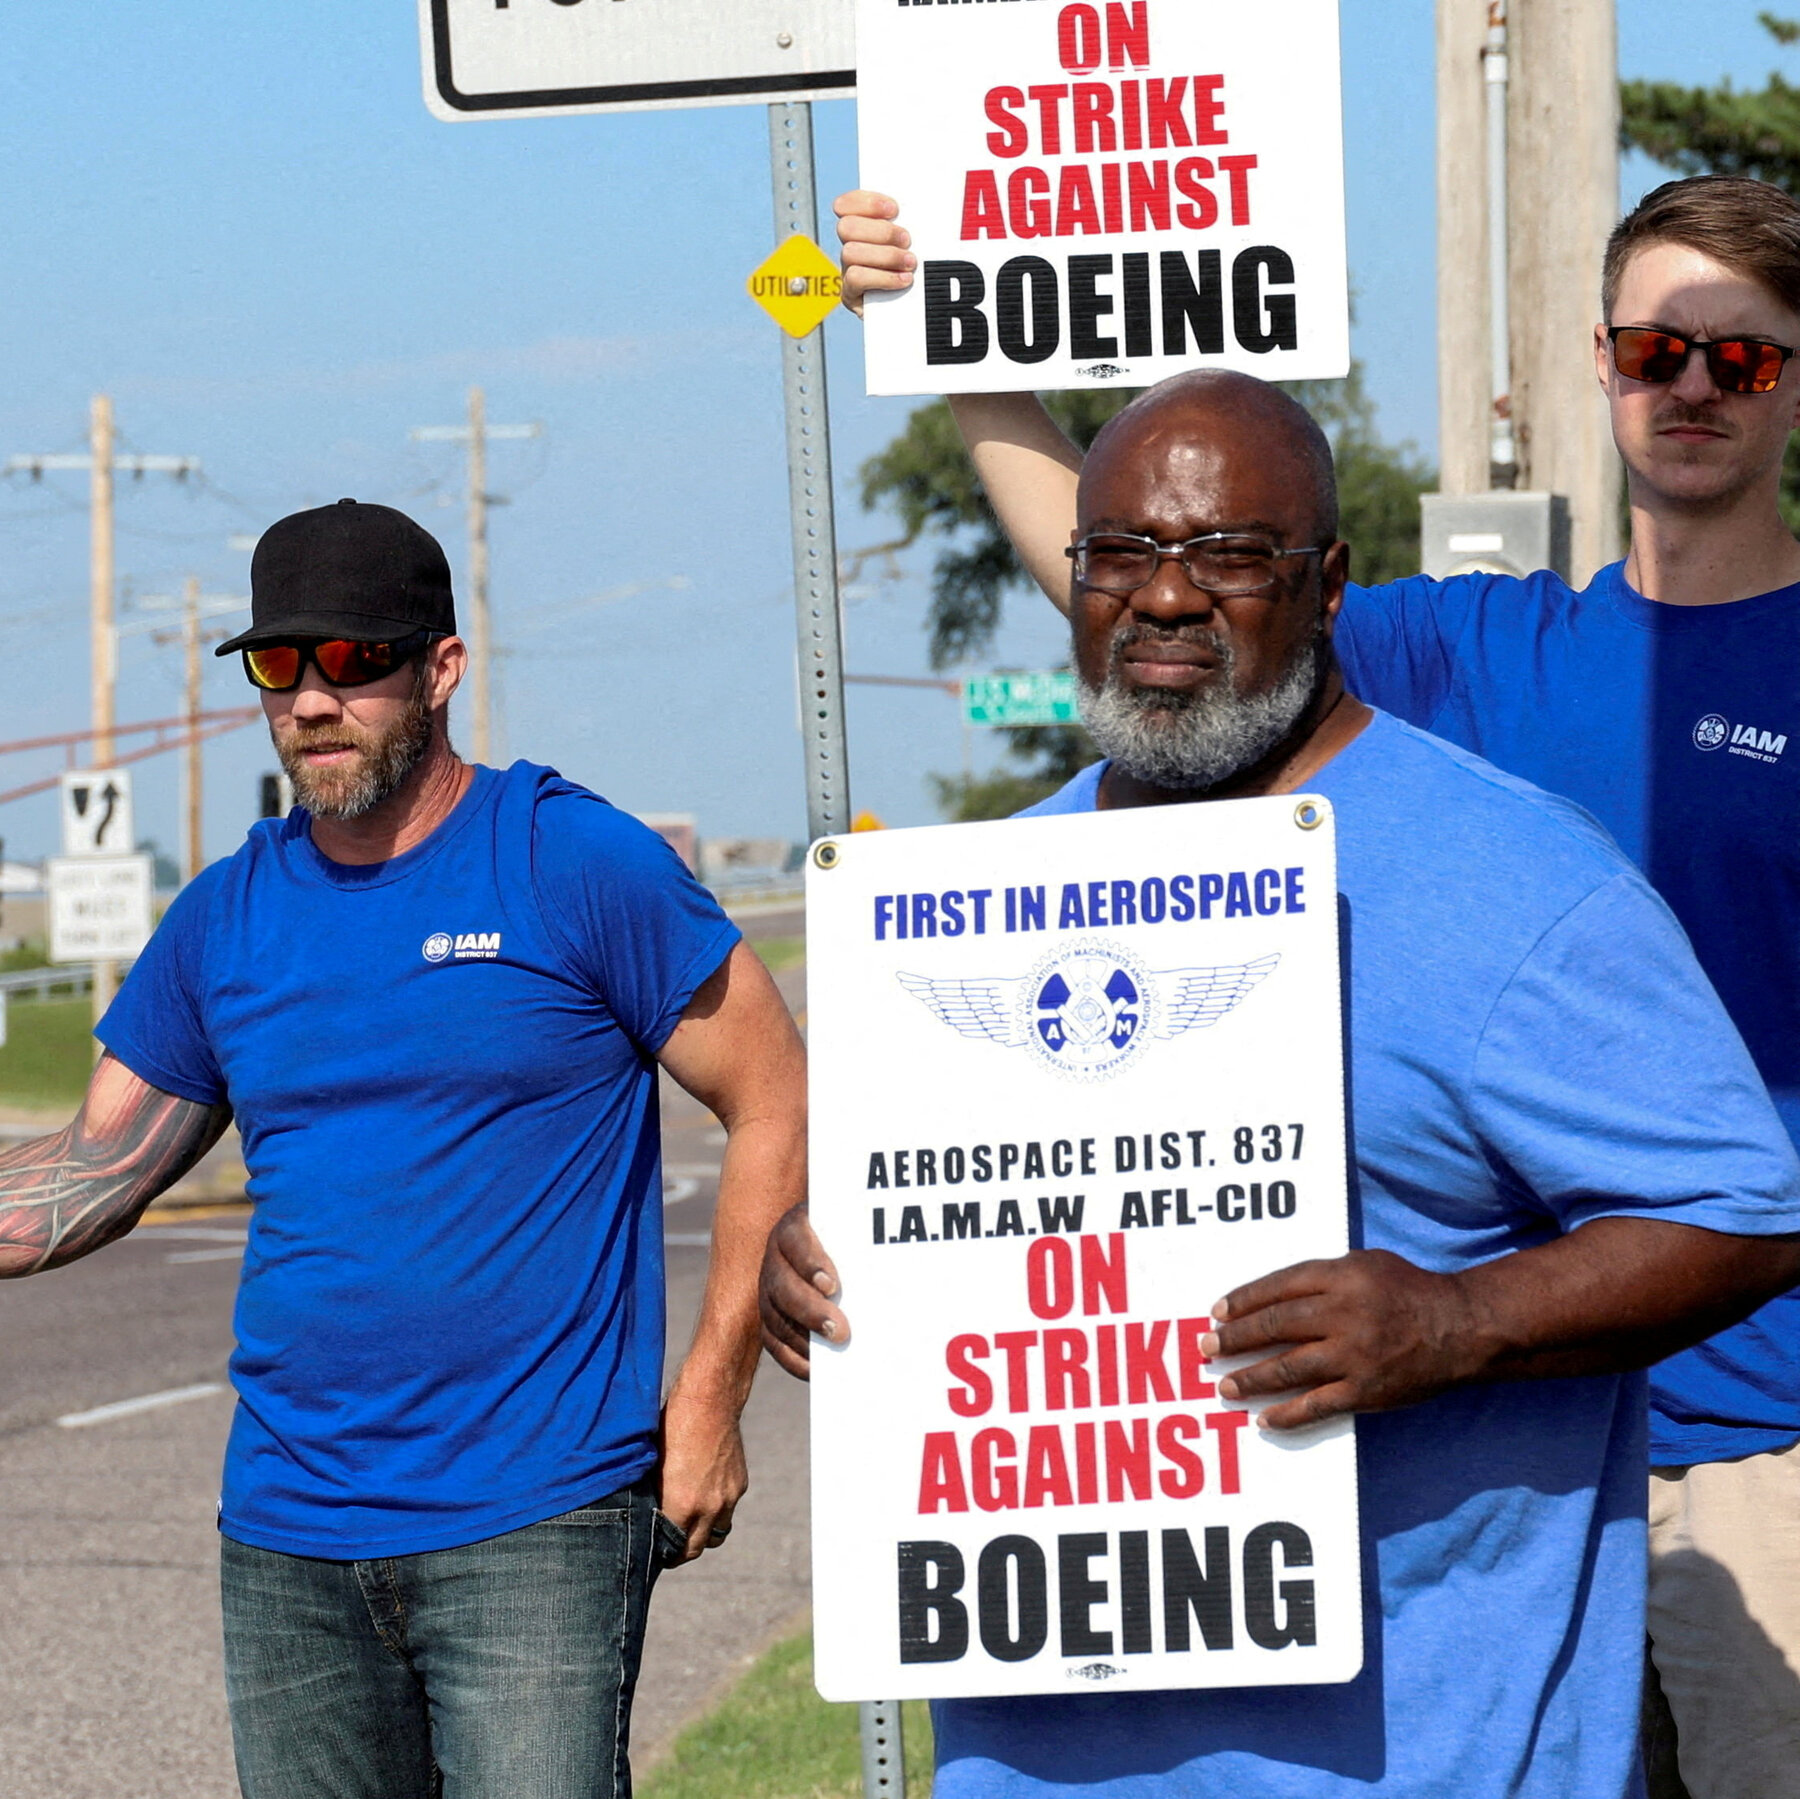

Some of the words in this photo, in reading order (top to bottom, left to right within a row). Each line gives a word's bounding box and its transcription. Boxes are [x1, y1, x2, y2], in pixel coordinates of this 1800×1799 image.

[1057, 1, 1150, 76] ON
[984, 74, 1228, 158] STRIKE
[960, 154, 1258, 241] AGAINST
[753, 275, 843, 297] UTILTIES
[923, 245, 1298, 365] BOEING
[1728, 746, 1763, 760] DISTRICT
[1730, 724, 1788, 755] IAM
[874, 889, 992, 940] FIRST
[1005, 885, 1046, 933] IN
[1058, 866, 1306, 929] AEROSPACE
[454, 932, 501, 950] IAM
[454, 950, 485, 958] DISTRICT
[867, 1138, 1097, 1189] AEROSPACE
[1115, 1130, 1216, 1173] DIST.
[1233, 1123, 1305, 1165] 837
[872, 1195, 1085, 1245] I.A.M.A.W
[1119, 1180, 1298, 1229] AFL-CIO
[1027, 1232, 1129, 1320] ON
[945, 1316, 1216, 1418] STRIKE
[917, 1410, 1249, 1514] AGAINST
[897, 1520, 1318, 1665] BOEING
